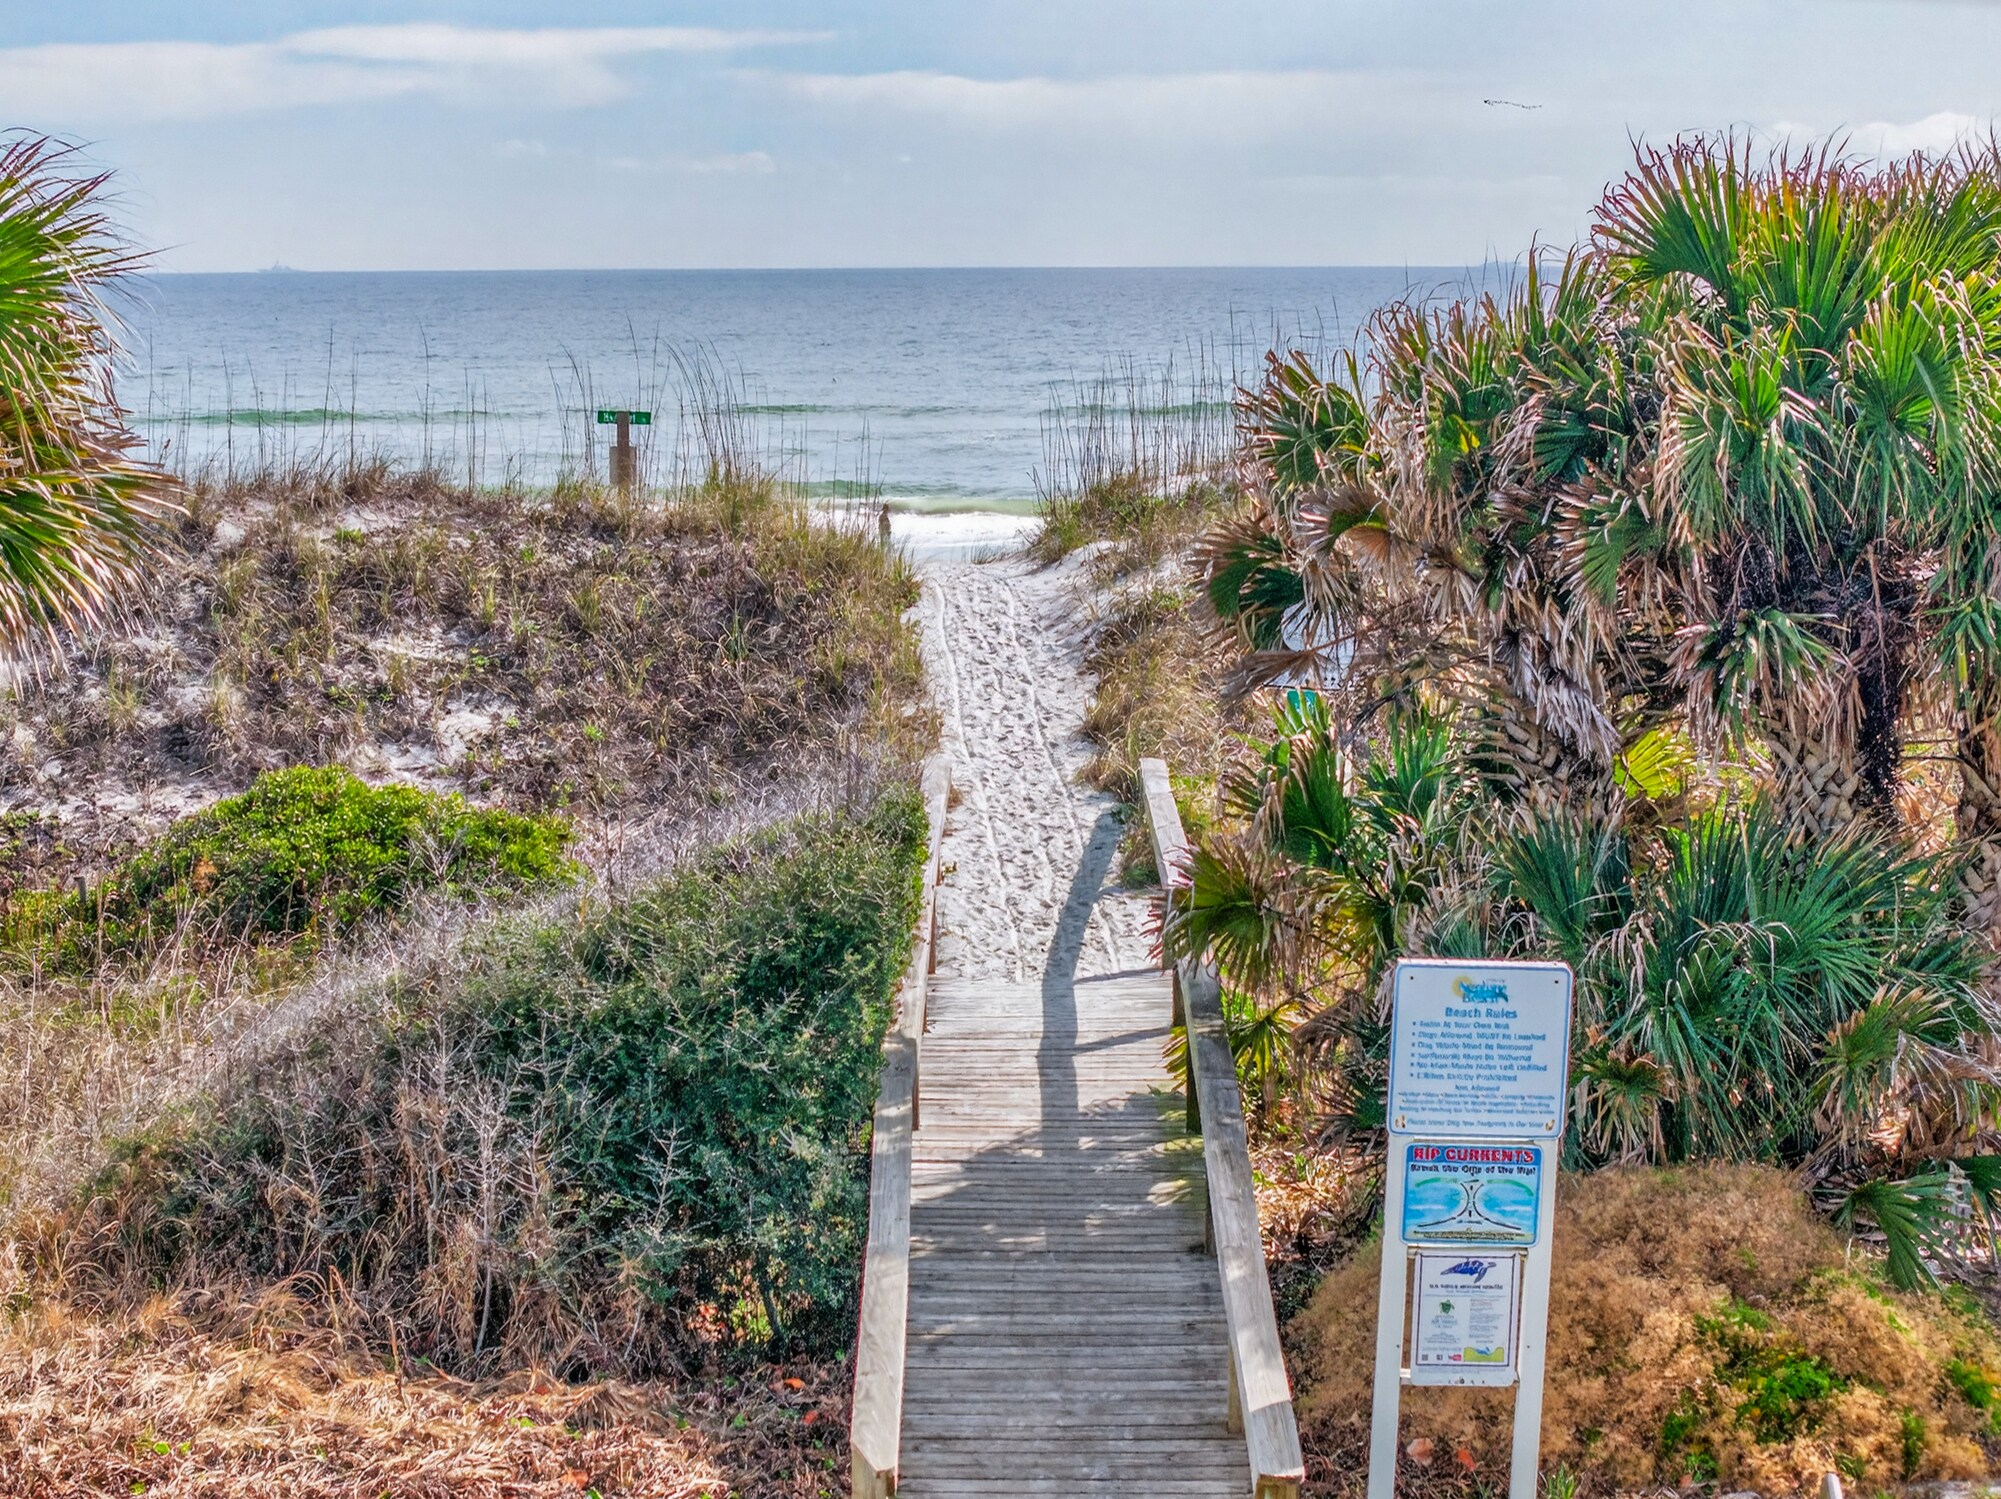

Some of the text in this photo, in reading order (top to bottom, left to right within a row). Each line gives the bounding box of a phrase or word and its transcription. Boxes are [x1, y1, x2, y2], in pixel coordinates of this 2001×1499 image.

[1445, 1007, 1517, 1018] Beach Rules
[1414, 1147, 1534, 1163] RIP CURRENTS
